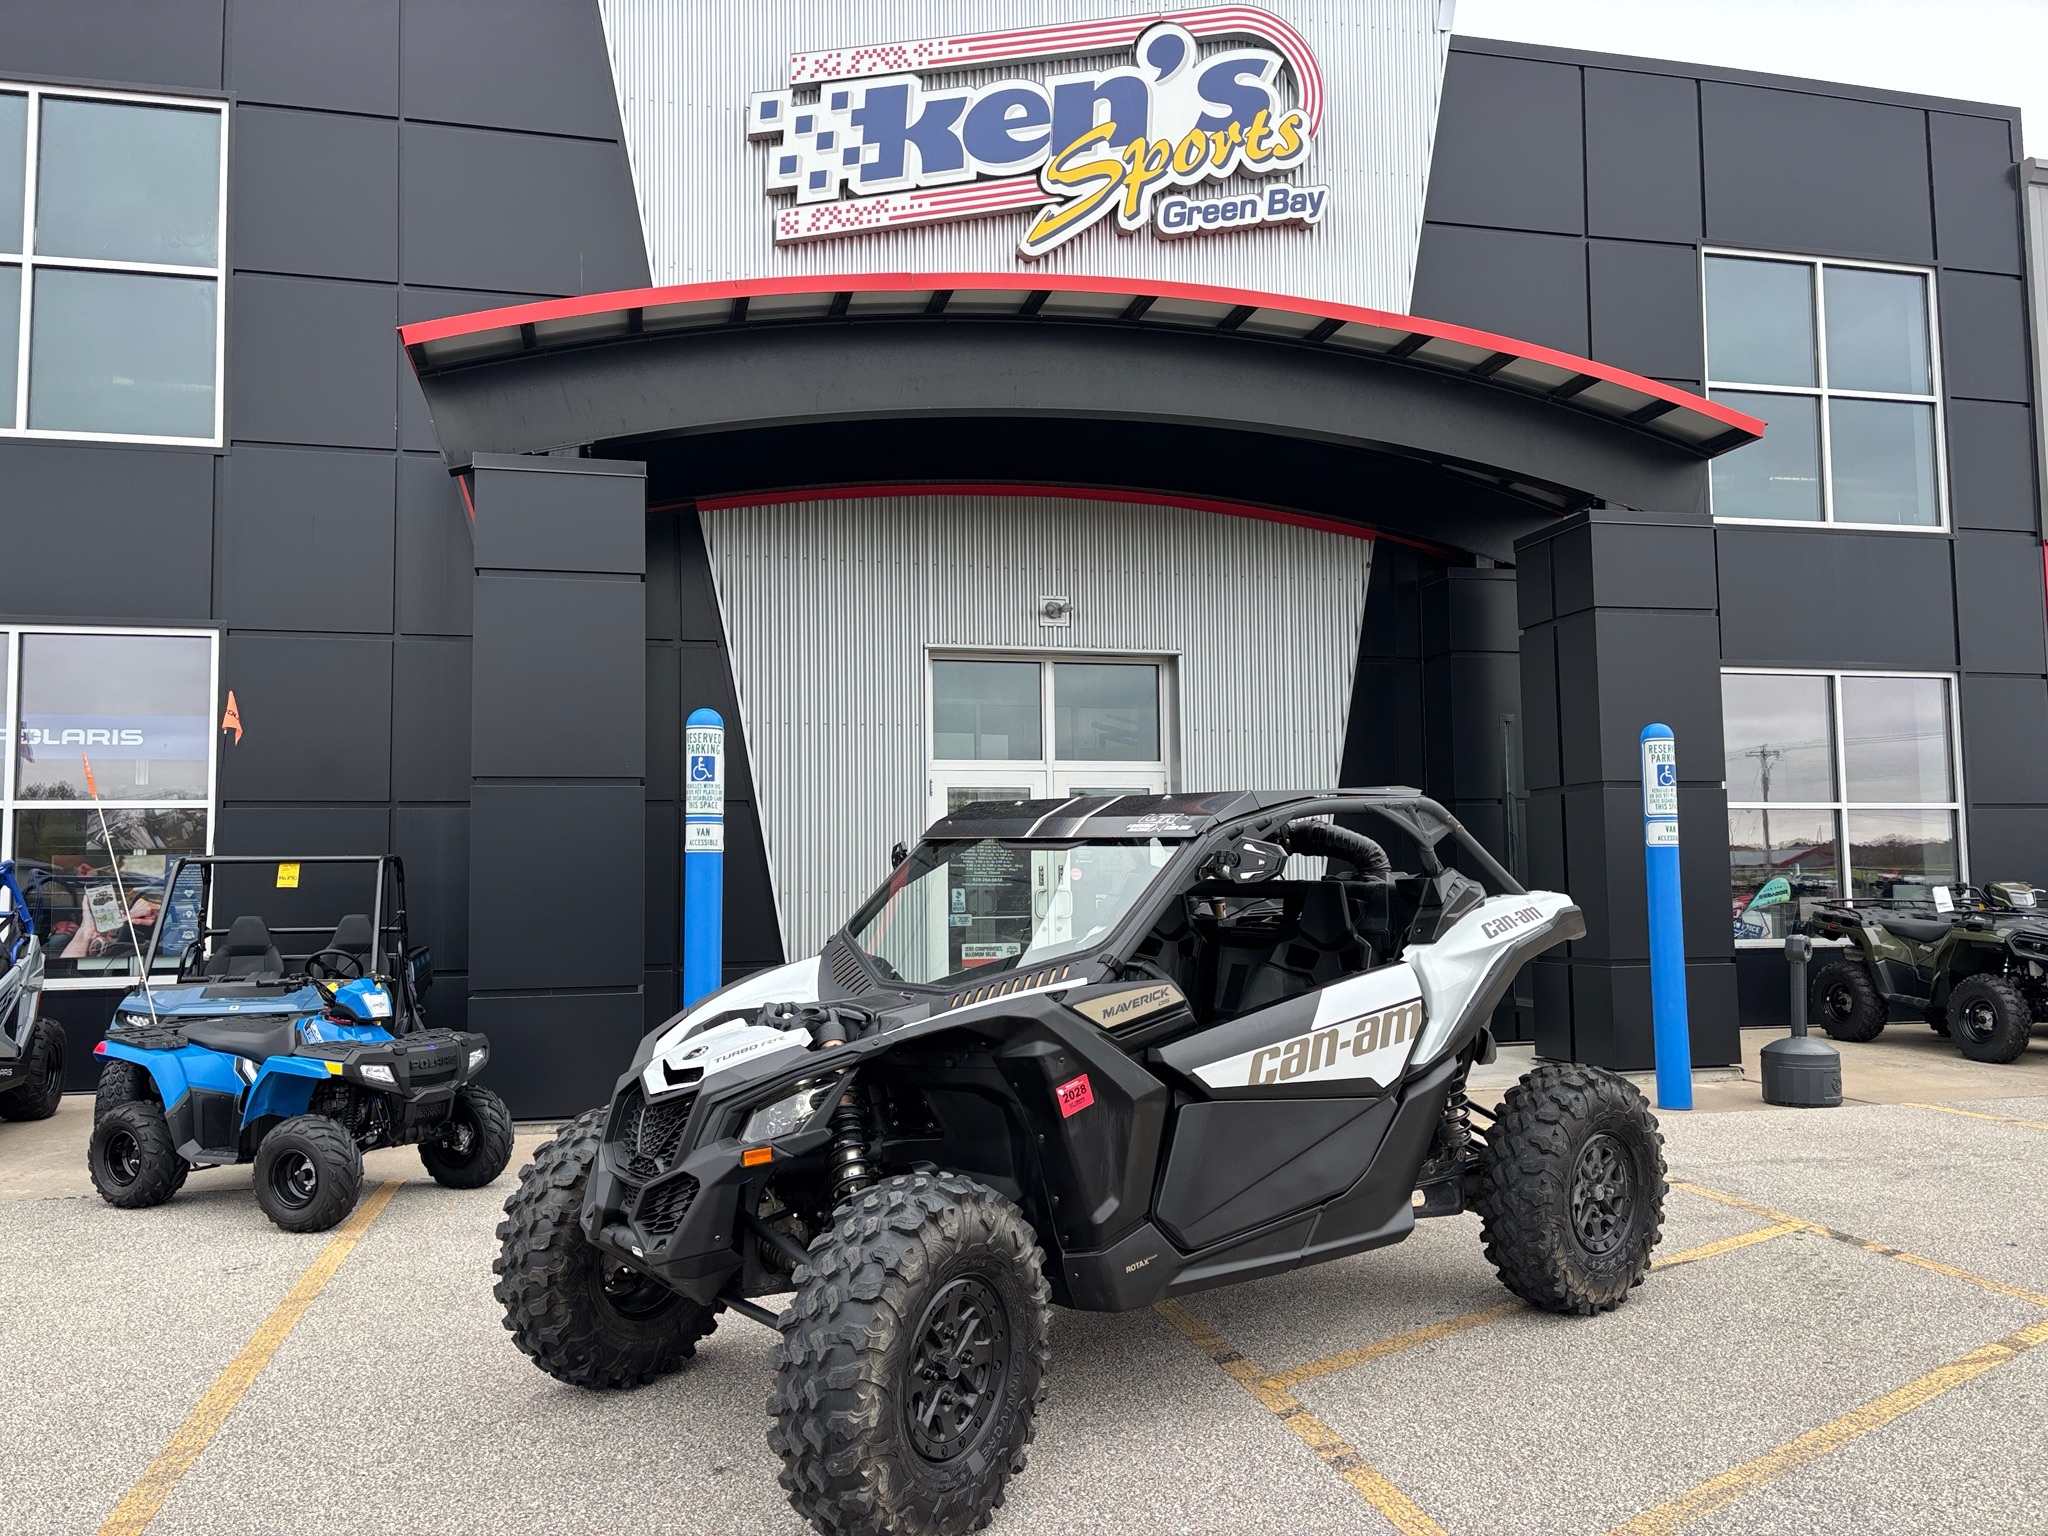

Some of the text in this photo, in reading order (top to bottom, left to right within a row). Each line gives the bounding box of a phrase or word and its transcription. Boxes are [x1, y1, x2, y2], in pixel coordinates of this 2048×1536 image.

[1028, 108, 1306, 244] Sports
[1163, 188, 1325, 227] Green Bay
[687, 733, 721, 744] RESERVED
[688, 744, 720, 755] PARKING
[700, 801, 718, 809] SPACE
[696, 828, 710, 836] VAN
[689, 839, 718, 847] ACCESSIBLE
[1102, 986, 1169, 1019] MAVERICK
[1248, 1003, 1421, 1085] can-am
[714, 1044, 758, 1064] TURBO
[1063, 1084, 1087, 1104] 2028
[1125, 1257, 1149, 1274] ROTAX
